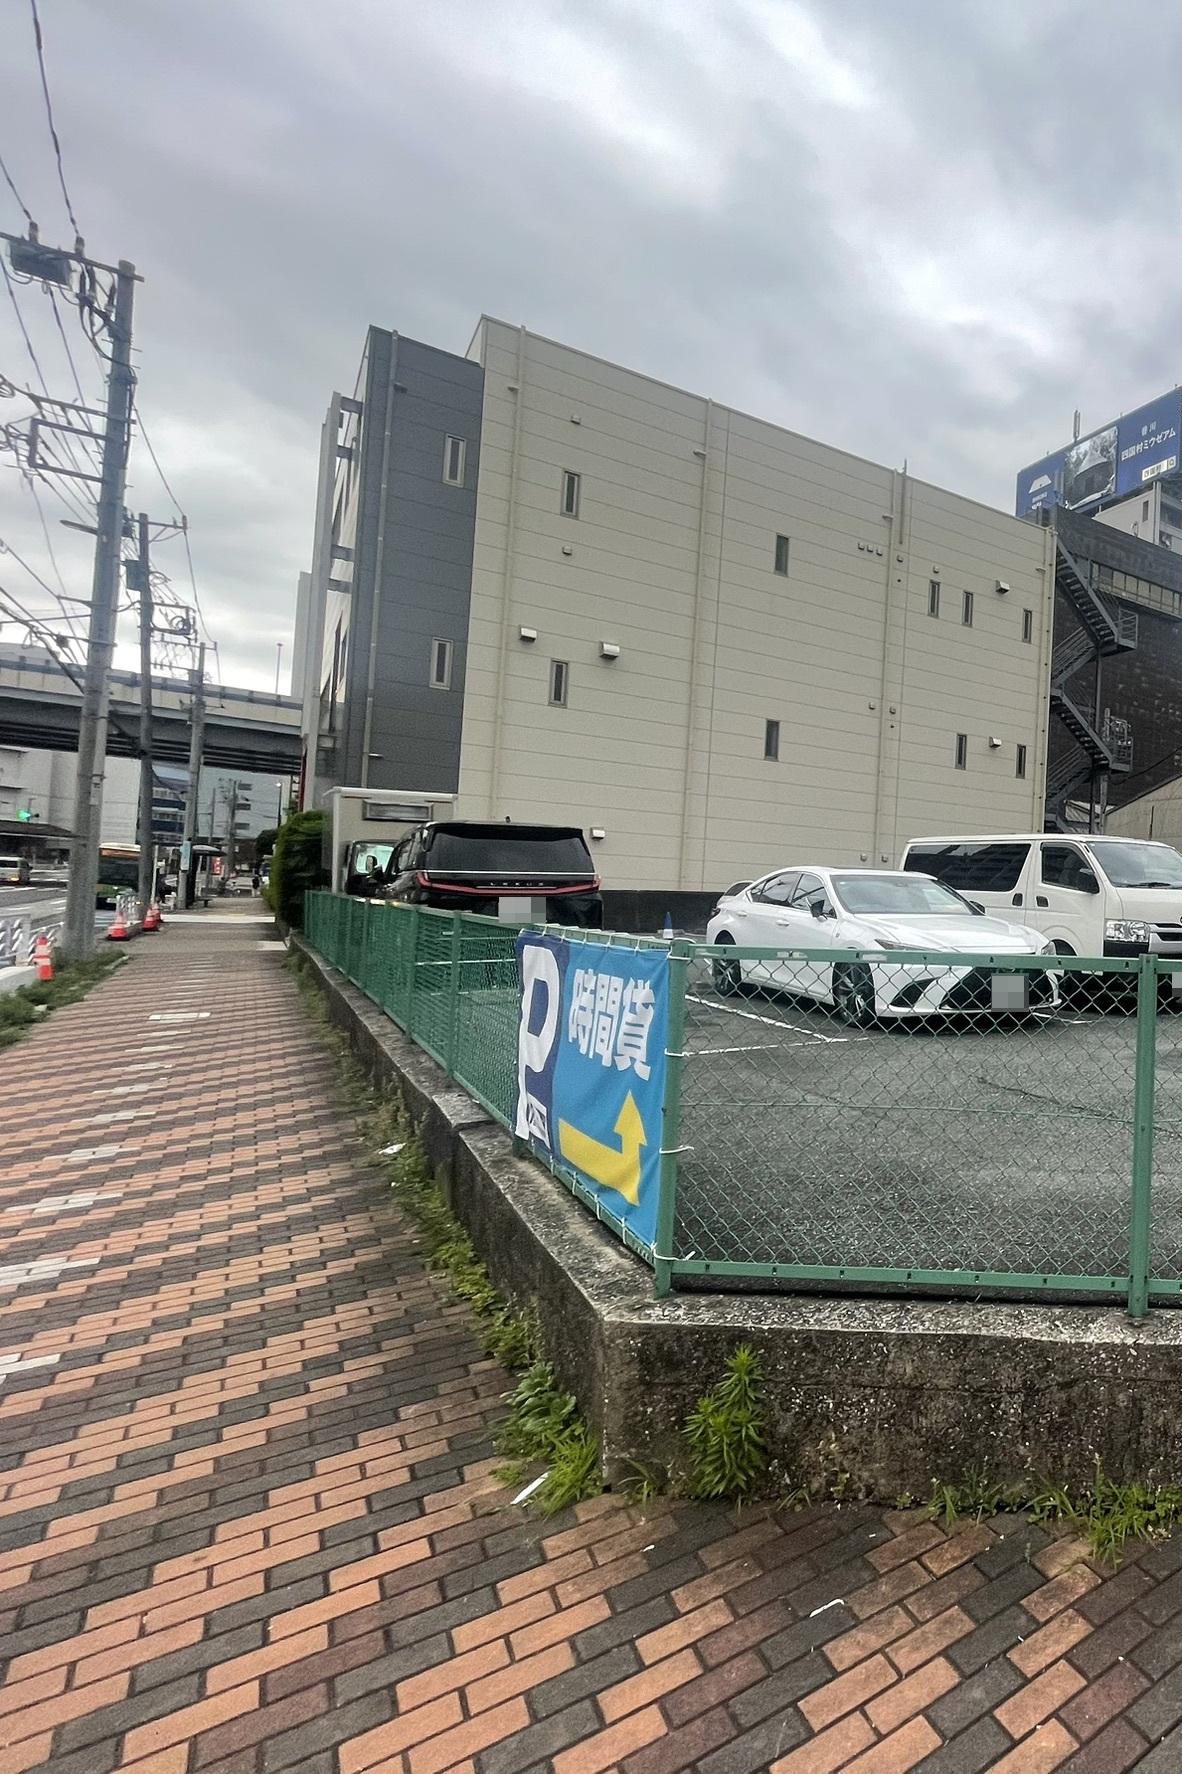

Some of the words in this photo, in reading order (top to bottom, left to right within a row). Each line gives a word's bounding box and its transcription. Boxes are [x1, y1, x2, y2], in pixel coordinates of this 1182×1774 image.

[514, 945, 560, 1140] P
[569, 968, 656, 1081] 時間貸
